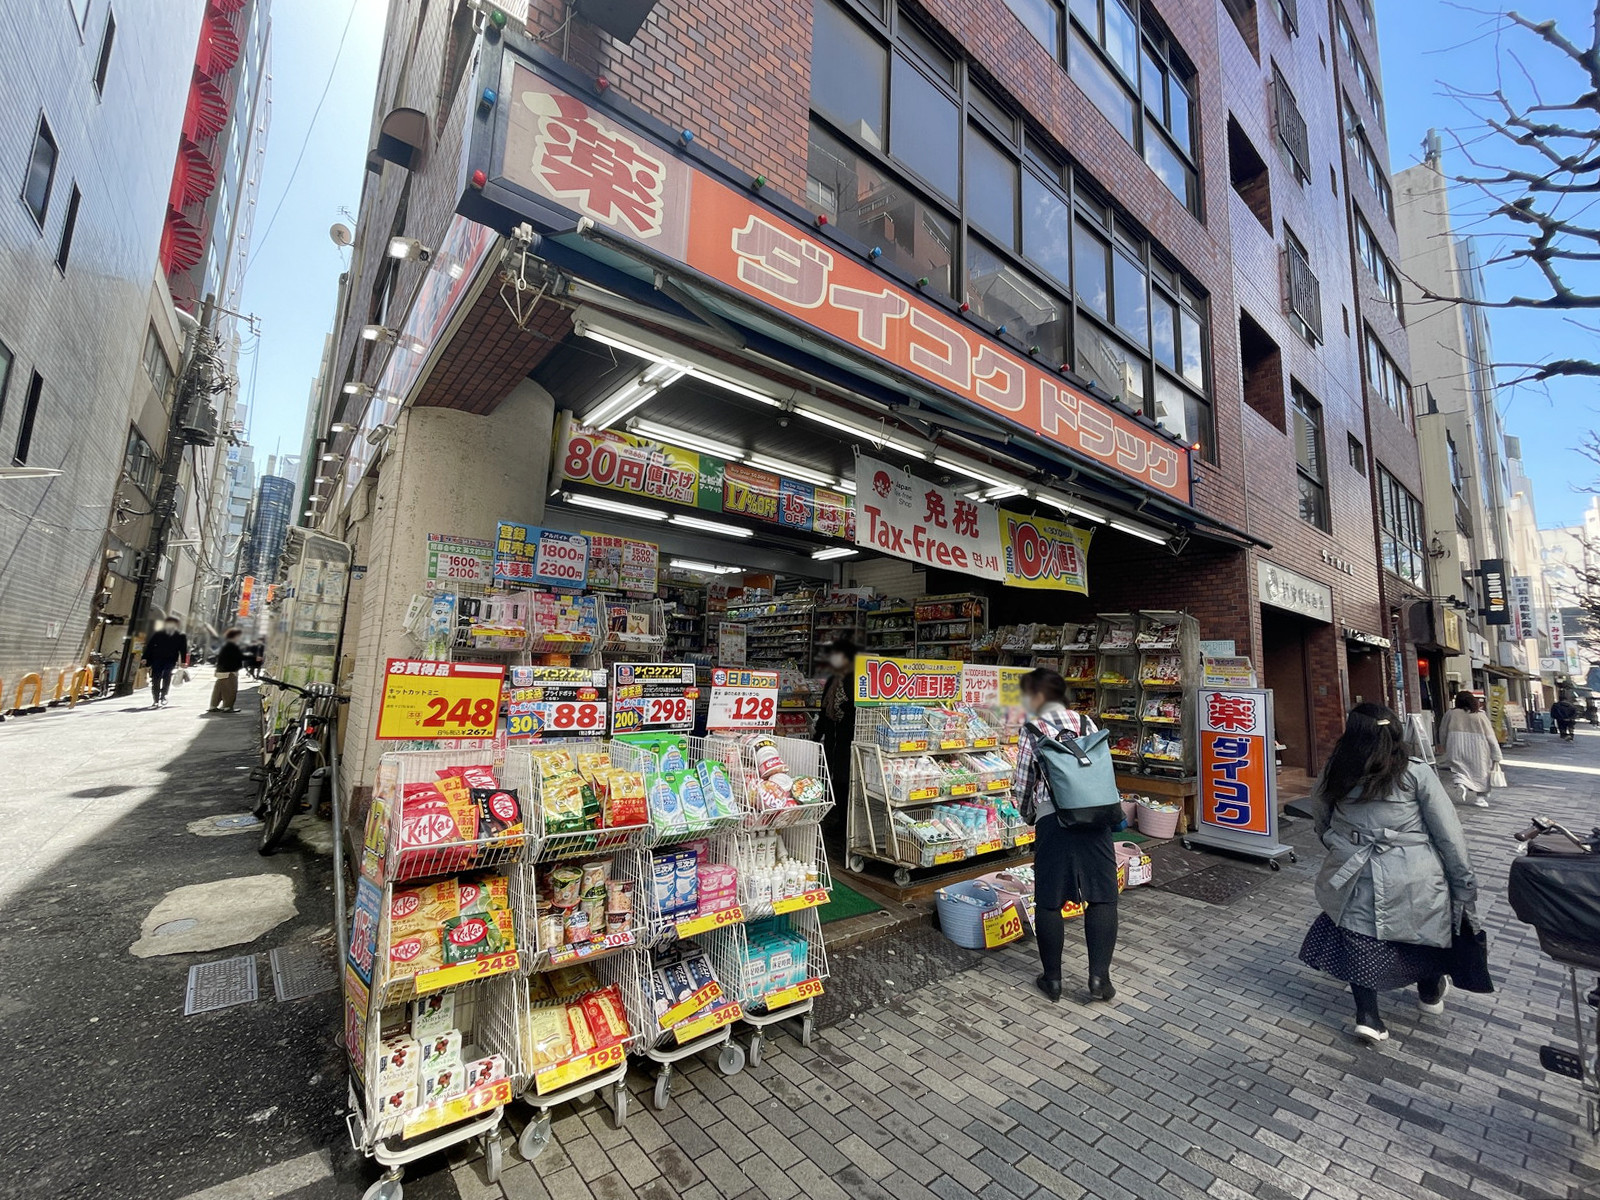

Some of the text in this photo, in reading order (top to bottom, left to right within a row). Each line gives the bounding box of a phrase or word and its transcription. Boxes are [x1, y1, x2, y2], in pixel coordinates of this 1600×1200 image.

[522, 90, 666, 240] 薬
[731, 213, 1180, 490] ダイコク ドラッグ
[563, 436, 646, 491] 80円
[647, 463, 696, 489] 値下げ
[785, 513, 807, 525] OFF
[923, 489, 980, 539] 免税
[501, 524, 527, 541] 登録
[543, 532, 568, 540] アルバイト
[818, 520, 840, 534] OFF
[864, 504, 968, 568] Tax-Free
[498, 540, 536, 557] 販売者
[542, 544, 585, 562] 1800円
[494, 561, 534, 578] 大募集
[972, 551, 999, 572] 면세
[539, 562, 583, 580] 2300円
[389, 661, 450, 677] お買得品
[534, 668, 592, 678] ダイコクアプリ
[634, 667, 682, 675] ダイコクアプリ
[867, 660, 957, 699] 10%値引券
[389, 688, 439, 696] キットカットミニ
[965, 691, 985, 703] 進呈!
[422, 697, 495, 728] 248
[553, 703, 598, 728] 88
[650, 699, 687, 723] 298
[732, 697, 774, 720] 128
[1205, 692, 1255, 732] 薬
[615, 711, 633, 728] 200
[1211, 735, 1252, 826] ダイコク
[458, 809, 473, 817] 史上
[406, 815, 452, 845] KitKat
[437, 880, 455, 891] 史上
[491, 879, 508, 888] 史上
[437, 891, 456, 901] 最高
[805, 891, 828, 904] 98
[392, 897, 419, 917] KitKat
[499, 910, 512, 919] 史上
[715, 908, 742, 924] 648
[453, 923, 483, 943] KitKat
[499, 919, 513, 929] 最高
[1000, 917, 1020, 939] 128
[606, 932, 630, 947] 108
[391, 942, 420, 959] KitKat
[478, 955, 517, 974] 248
[694, 984, 720, 1007] 118
[798, 981, 822, 997] 598
[713, 1005, 741, 1024] 348
[588, 1046, 622, 1070] 198
[468, 1085, 509, 1112] 198
